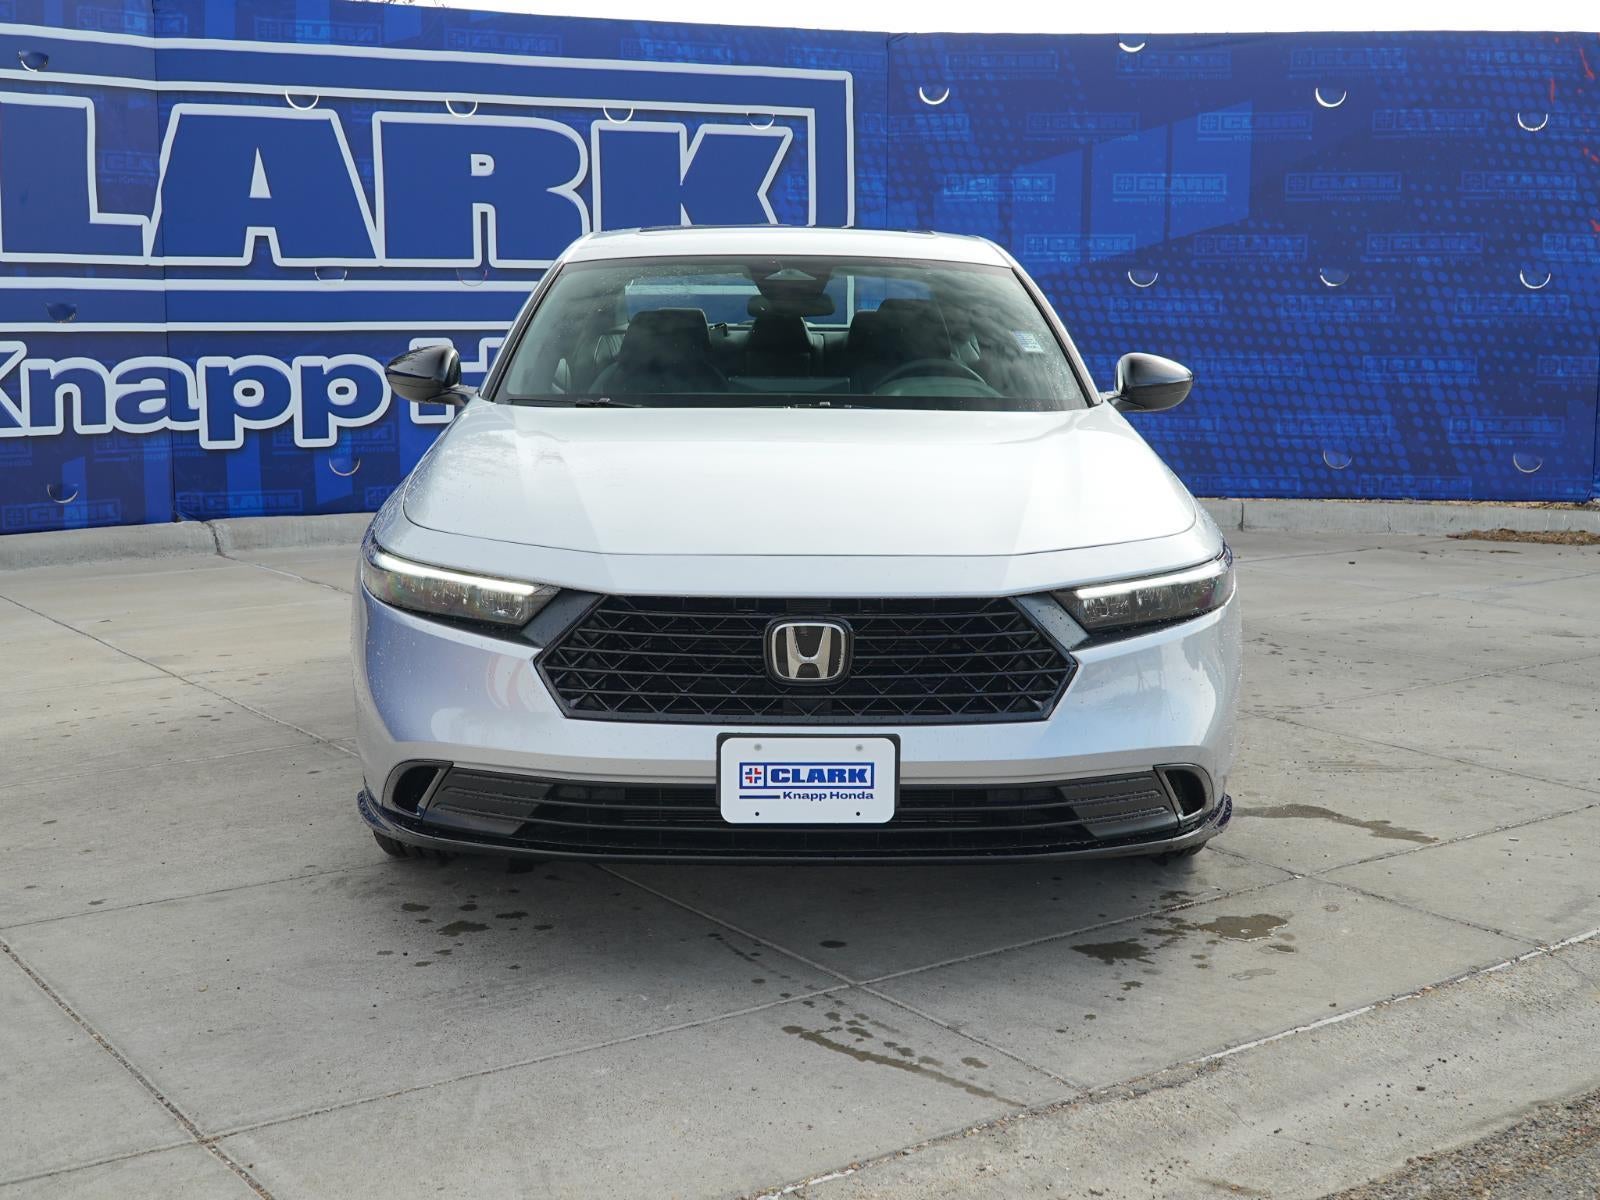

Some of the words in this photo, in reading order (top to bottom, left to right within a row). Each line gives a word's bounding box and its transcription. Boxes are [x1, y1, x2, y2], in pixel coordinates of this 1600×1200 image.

[0, 340, 391, 448] napp
[771, 768, 868, 783] CLARK
[783, 791, 827, 801] Knapp
[830, 791, 874, 800] Honda
